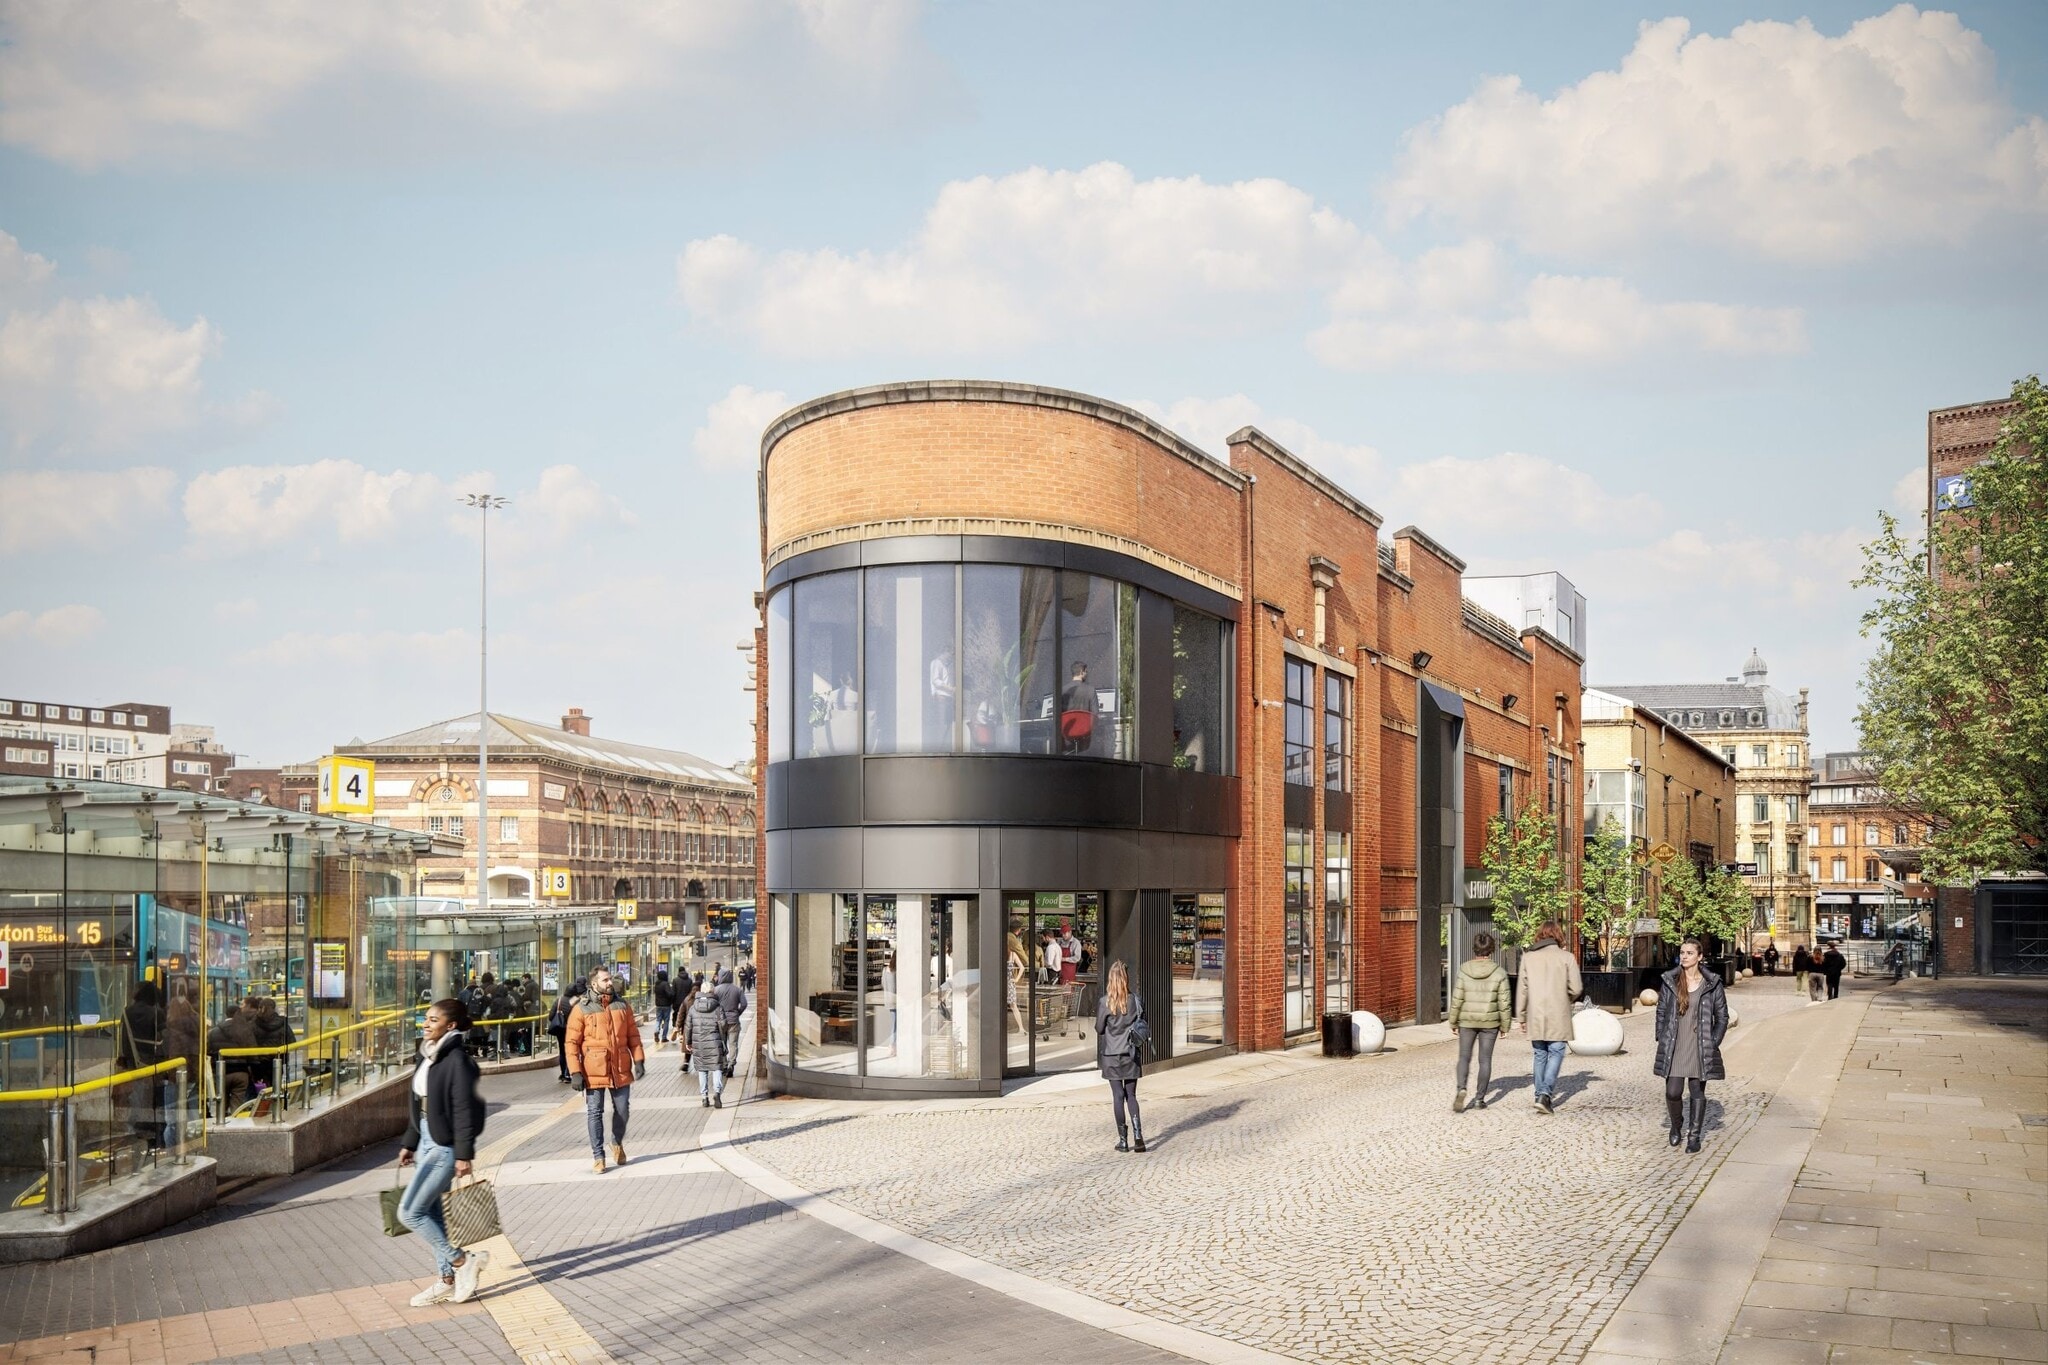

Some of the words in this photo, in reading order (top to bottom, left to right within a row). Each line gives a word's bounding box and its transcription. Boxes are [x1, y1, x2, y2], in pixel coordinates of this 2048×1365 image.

[323, 773, 329, 797] 4
[347, 774, 361, 798] 4
[557, 875, 564, 888] 3
[1041, 897, 1059, 907] food
[628, 905, 633, 914] 2
[37, 925, 53, 934] Bus
[77, 921, 101, 945] 15
